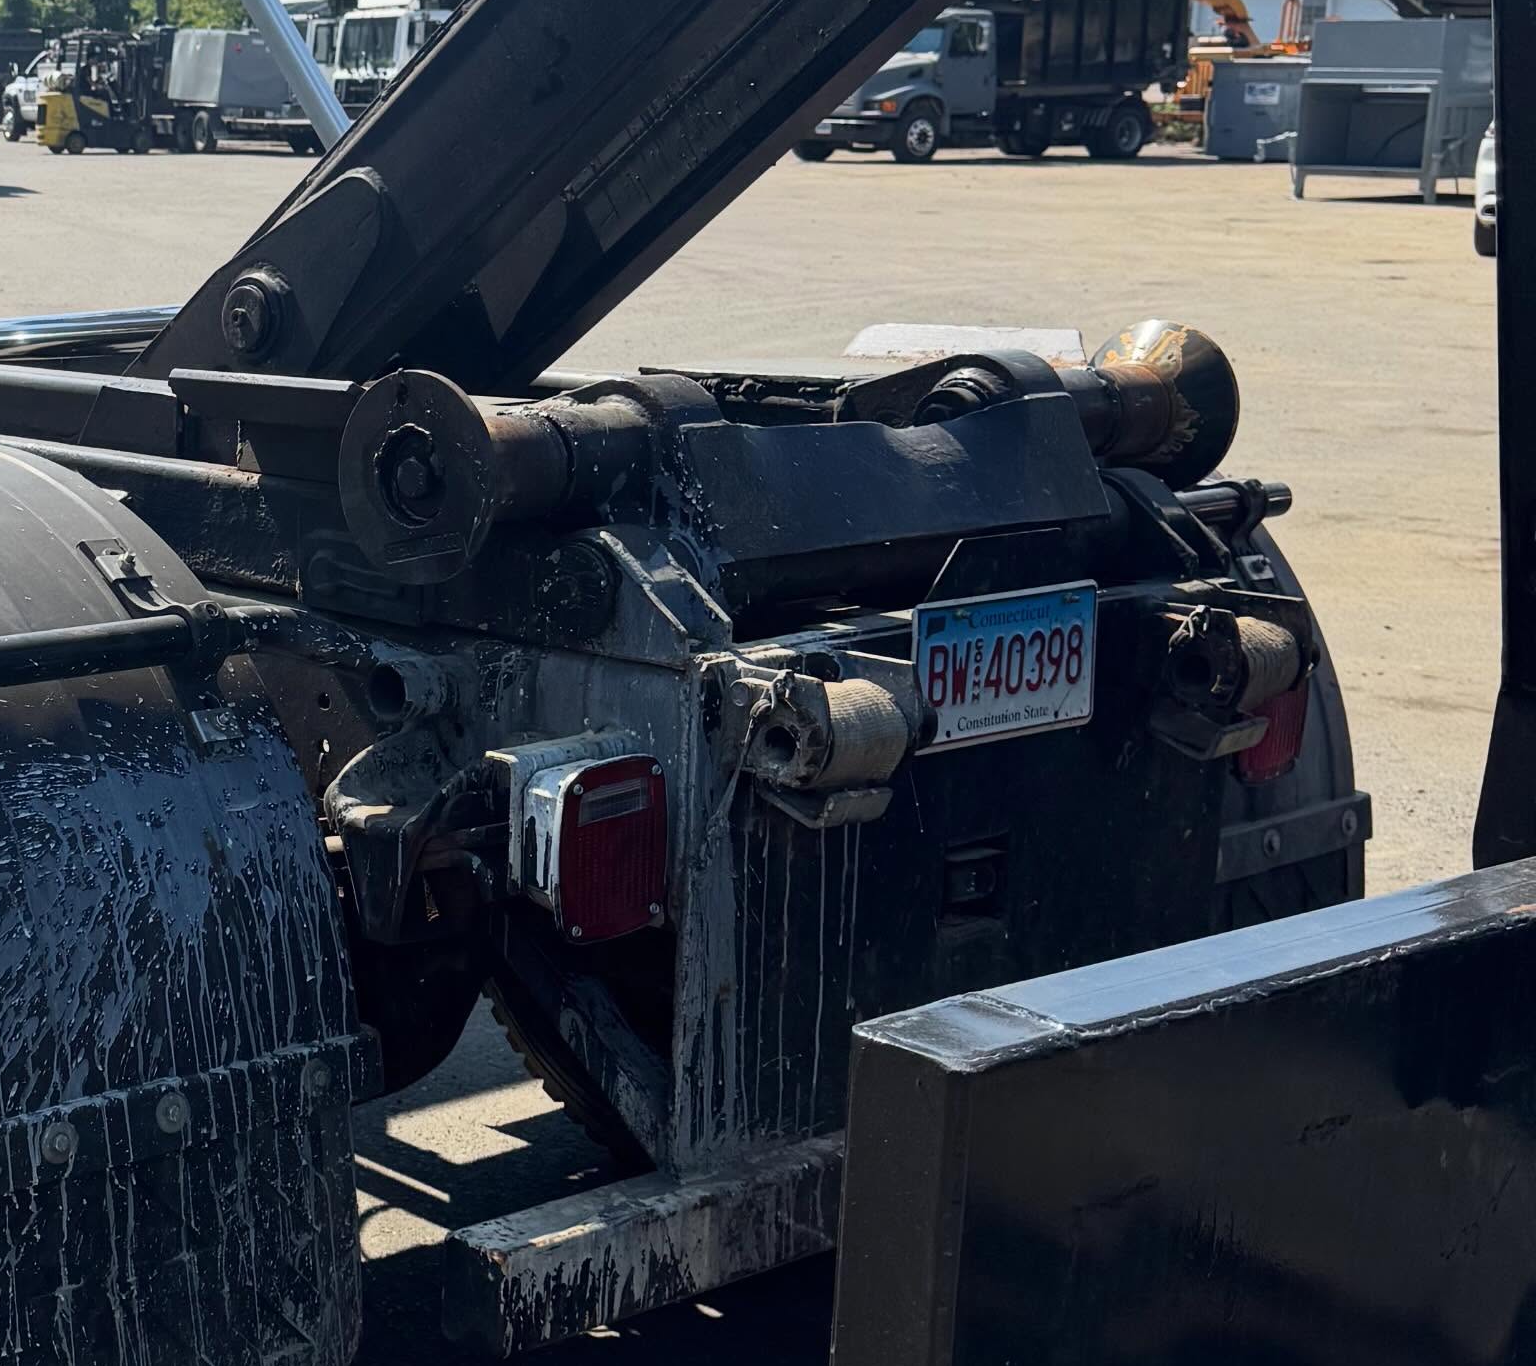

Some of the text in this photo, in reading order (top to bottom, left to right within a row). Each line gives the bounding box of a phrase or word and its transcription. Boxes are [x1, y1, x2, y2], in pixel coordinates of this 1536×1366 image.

[969, 603, 1050, 629] Connecticut
[928, 640, 972, 708] BW
[984, 623, 1083, 700] 40398
[957, 705, 1049, 732] Constitution State
